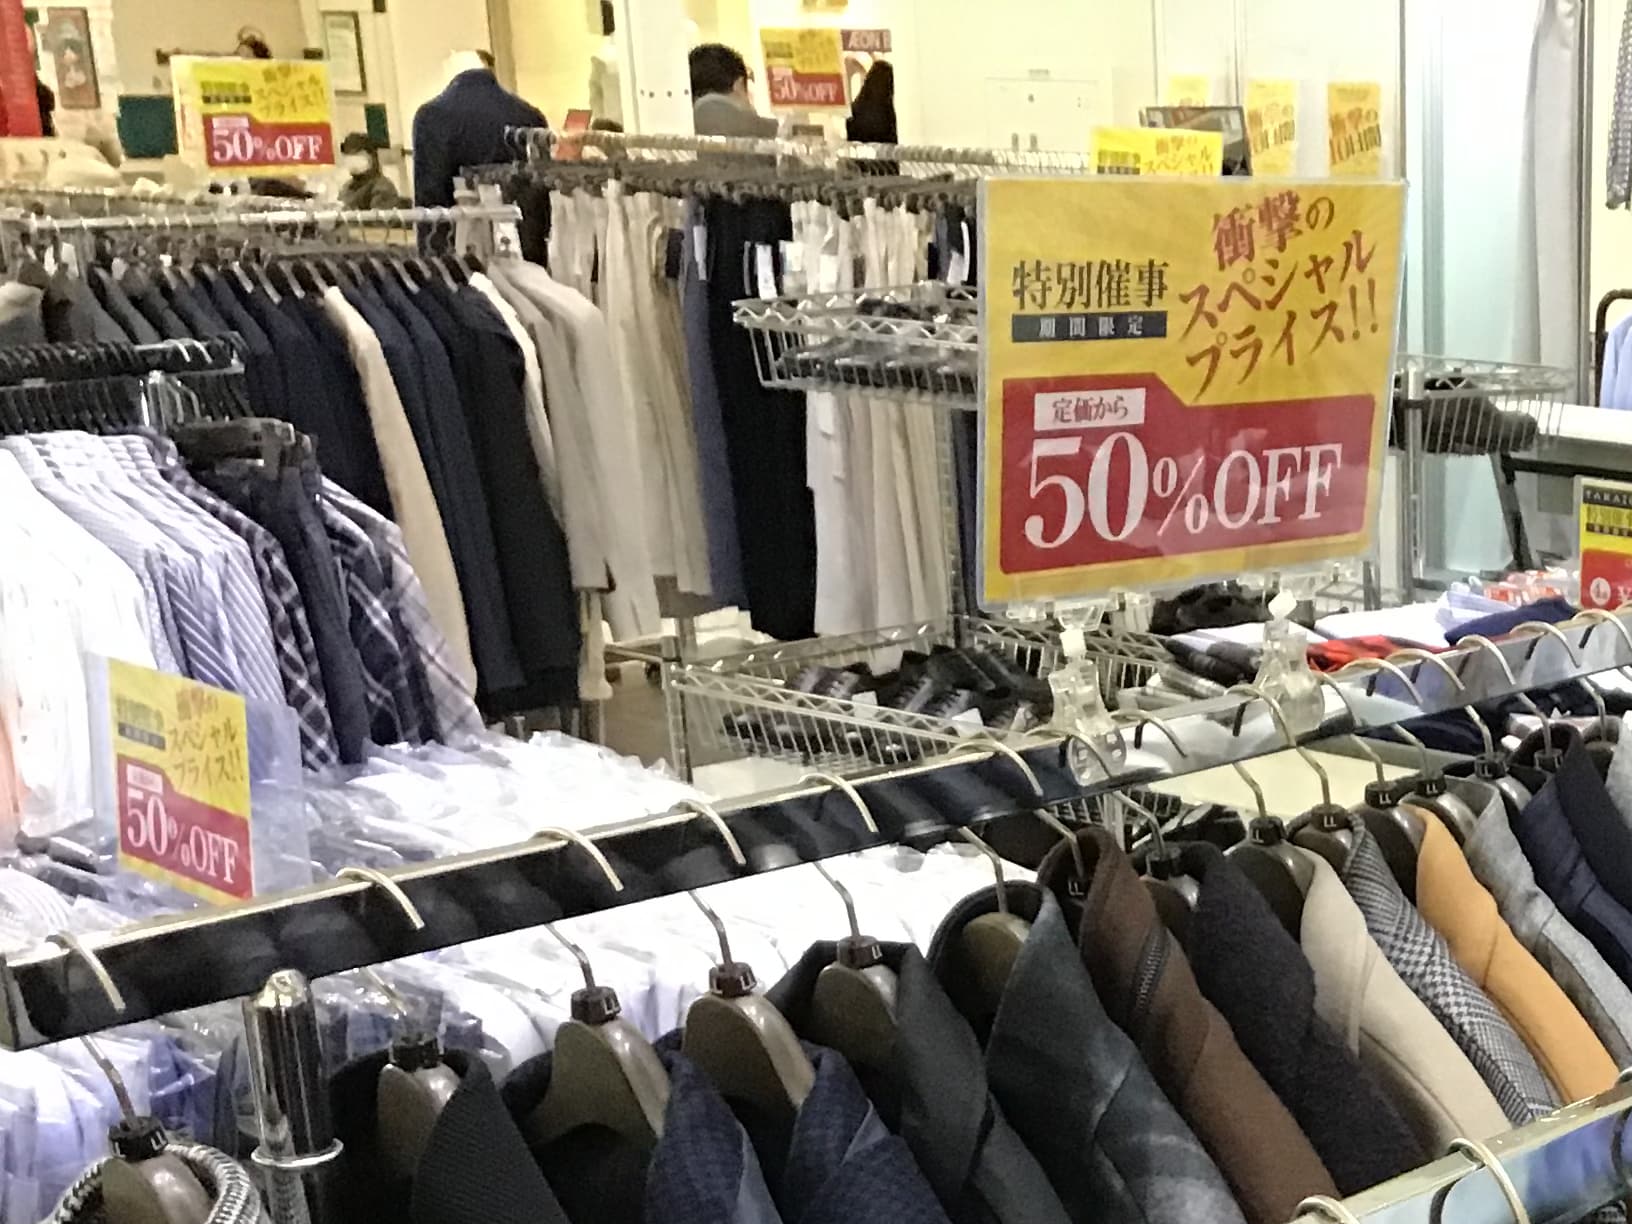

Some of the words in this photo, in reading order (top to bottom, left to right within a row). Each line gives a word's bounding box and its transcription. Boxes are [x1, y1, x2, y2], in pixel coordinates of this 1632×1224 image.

[212, 127, 323, 162] 50%OFF
[1212, 189, 1336, 269] 衝撃の
[1011, 258, 1169, 311] 特別催事
[1177, 228, 1378, 344] スペシャル
[1185, 278, 1379, 402] プライス!!
[1052, 394, 1129, 424] 定価から
[1024, 431, 1343, 549] 50%OFF
[126, 787, 239, 885] 50%OFF
